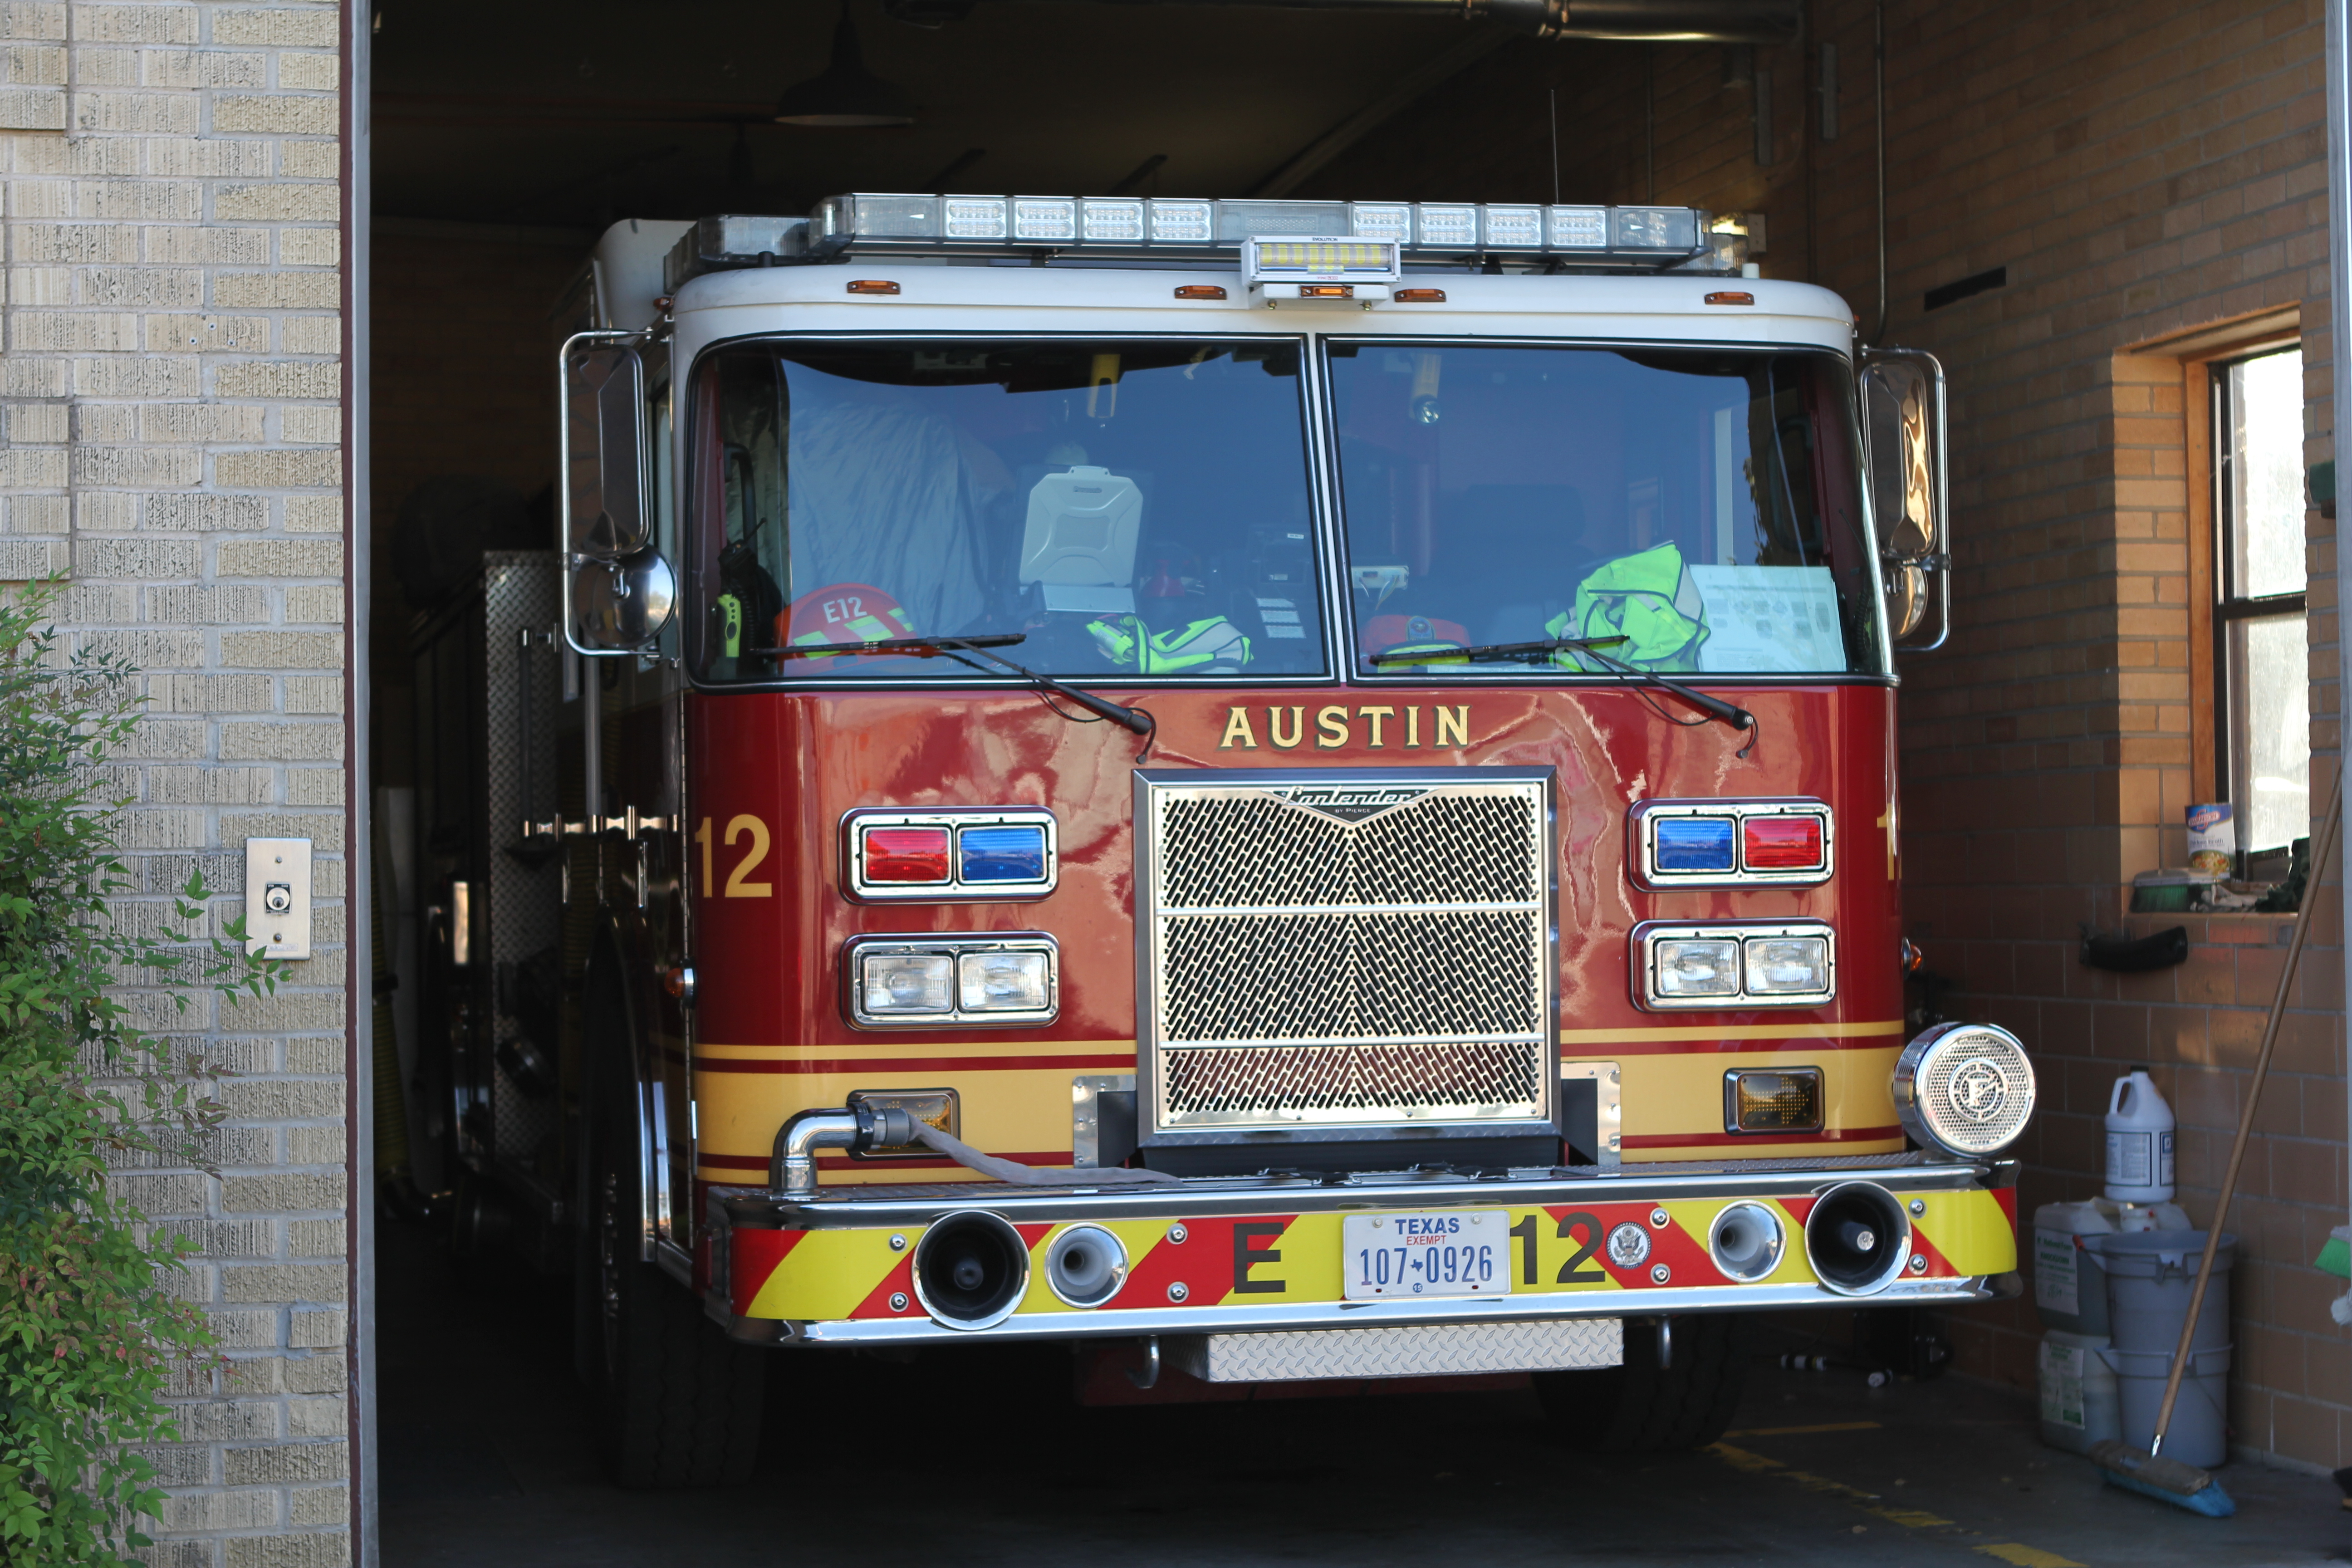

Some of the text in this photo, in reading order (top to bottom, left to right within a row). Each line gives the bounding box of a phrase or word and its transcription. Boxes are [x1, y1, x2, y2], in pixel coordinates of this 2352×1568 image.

[823, 596, 867, 623] E12
[1218, 705, 1471, 750] AUSTIN
[1283, 786, 1415, 806] Contender
[695, 814, 772, 897] 12
[1395, 1218, 1460, 1235] TEXAS
[1406, 1235, 1446, 1245] EXEMPT
[1234, 1222, 1286, 1294] E
[1361, 1245, 1493, 1286] 107 0926
[1510, 1212, 1606, 1285] 12
